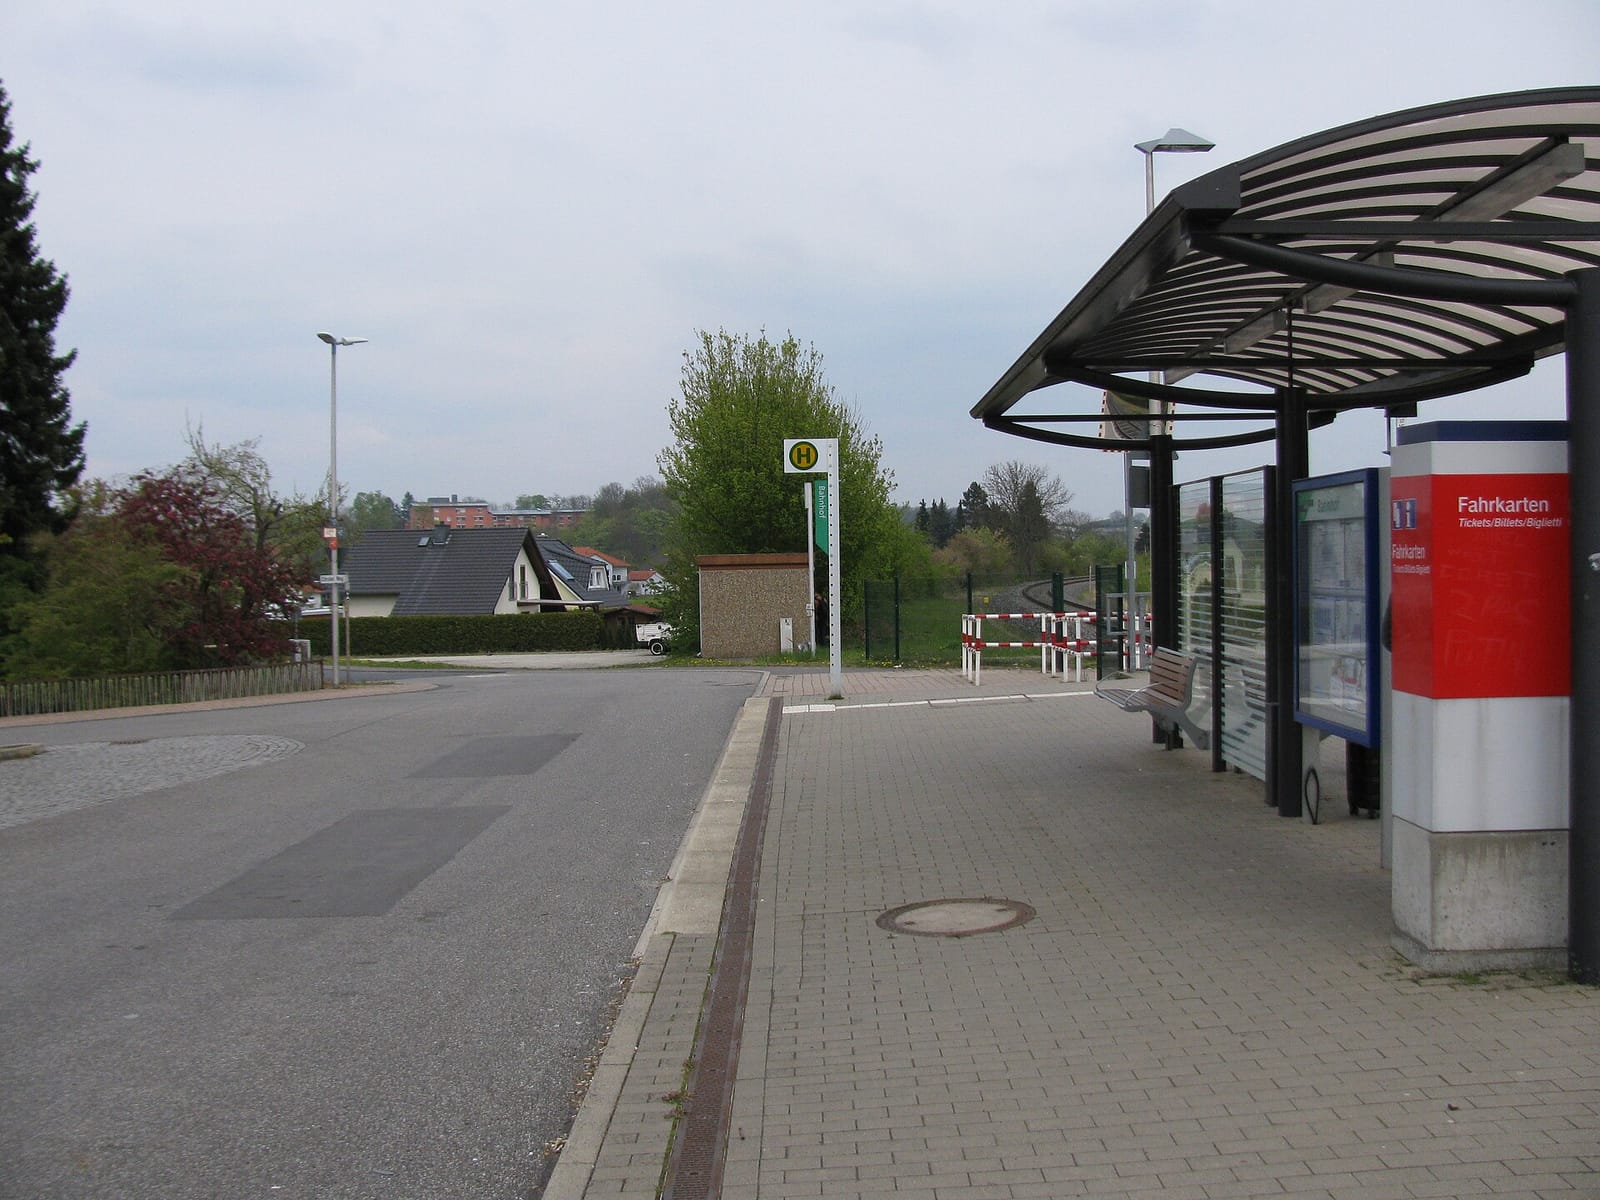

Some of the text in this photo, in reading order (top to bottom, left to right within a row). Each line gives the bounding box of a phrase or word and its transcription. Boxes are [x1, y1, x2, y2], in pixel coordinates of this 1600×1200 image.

[797, 448, 810, 464] H
[818, 486, 827, 518] Bahnhof
[1458, 497, 1549, 513] Fahrkarten
[1458, 518, 1562, 529] Tickets/Billets/Biglietti
[1391, 544, 1425, 559] Fahrkarten
